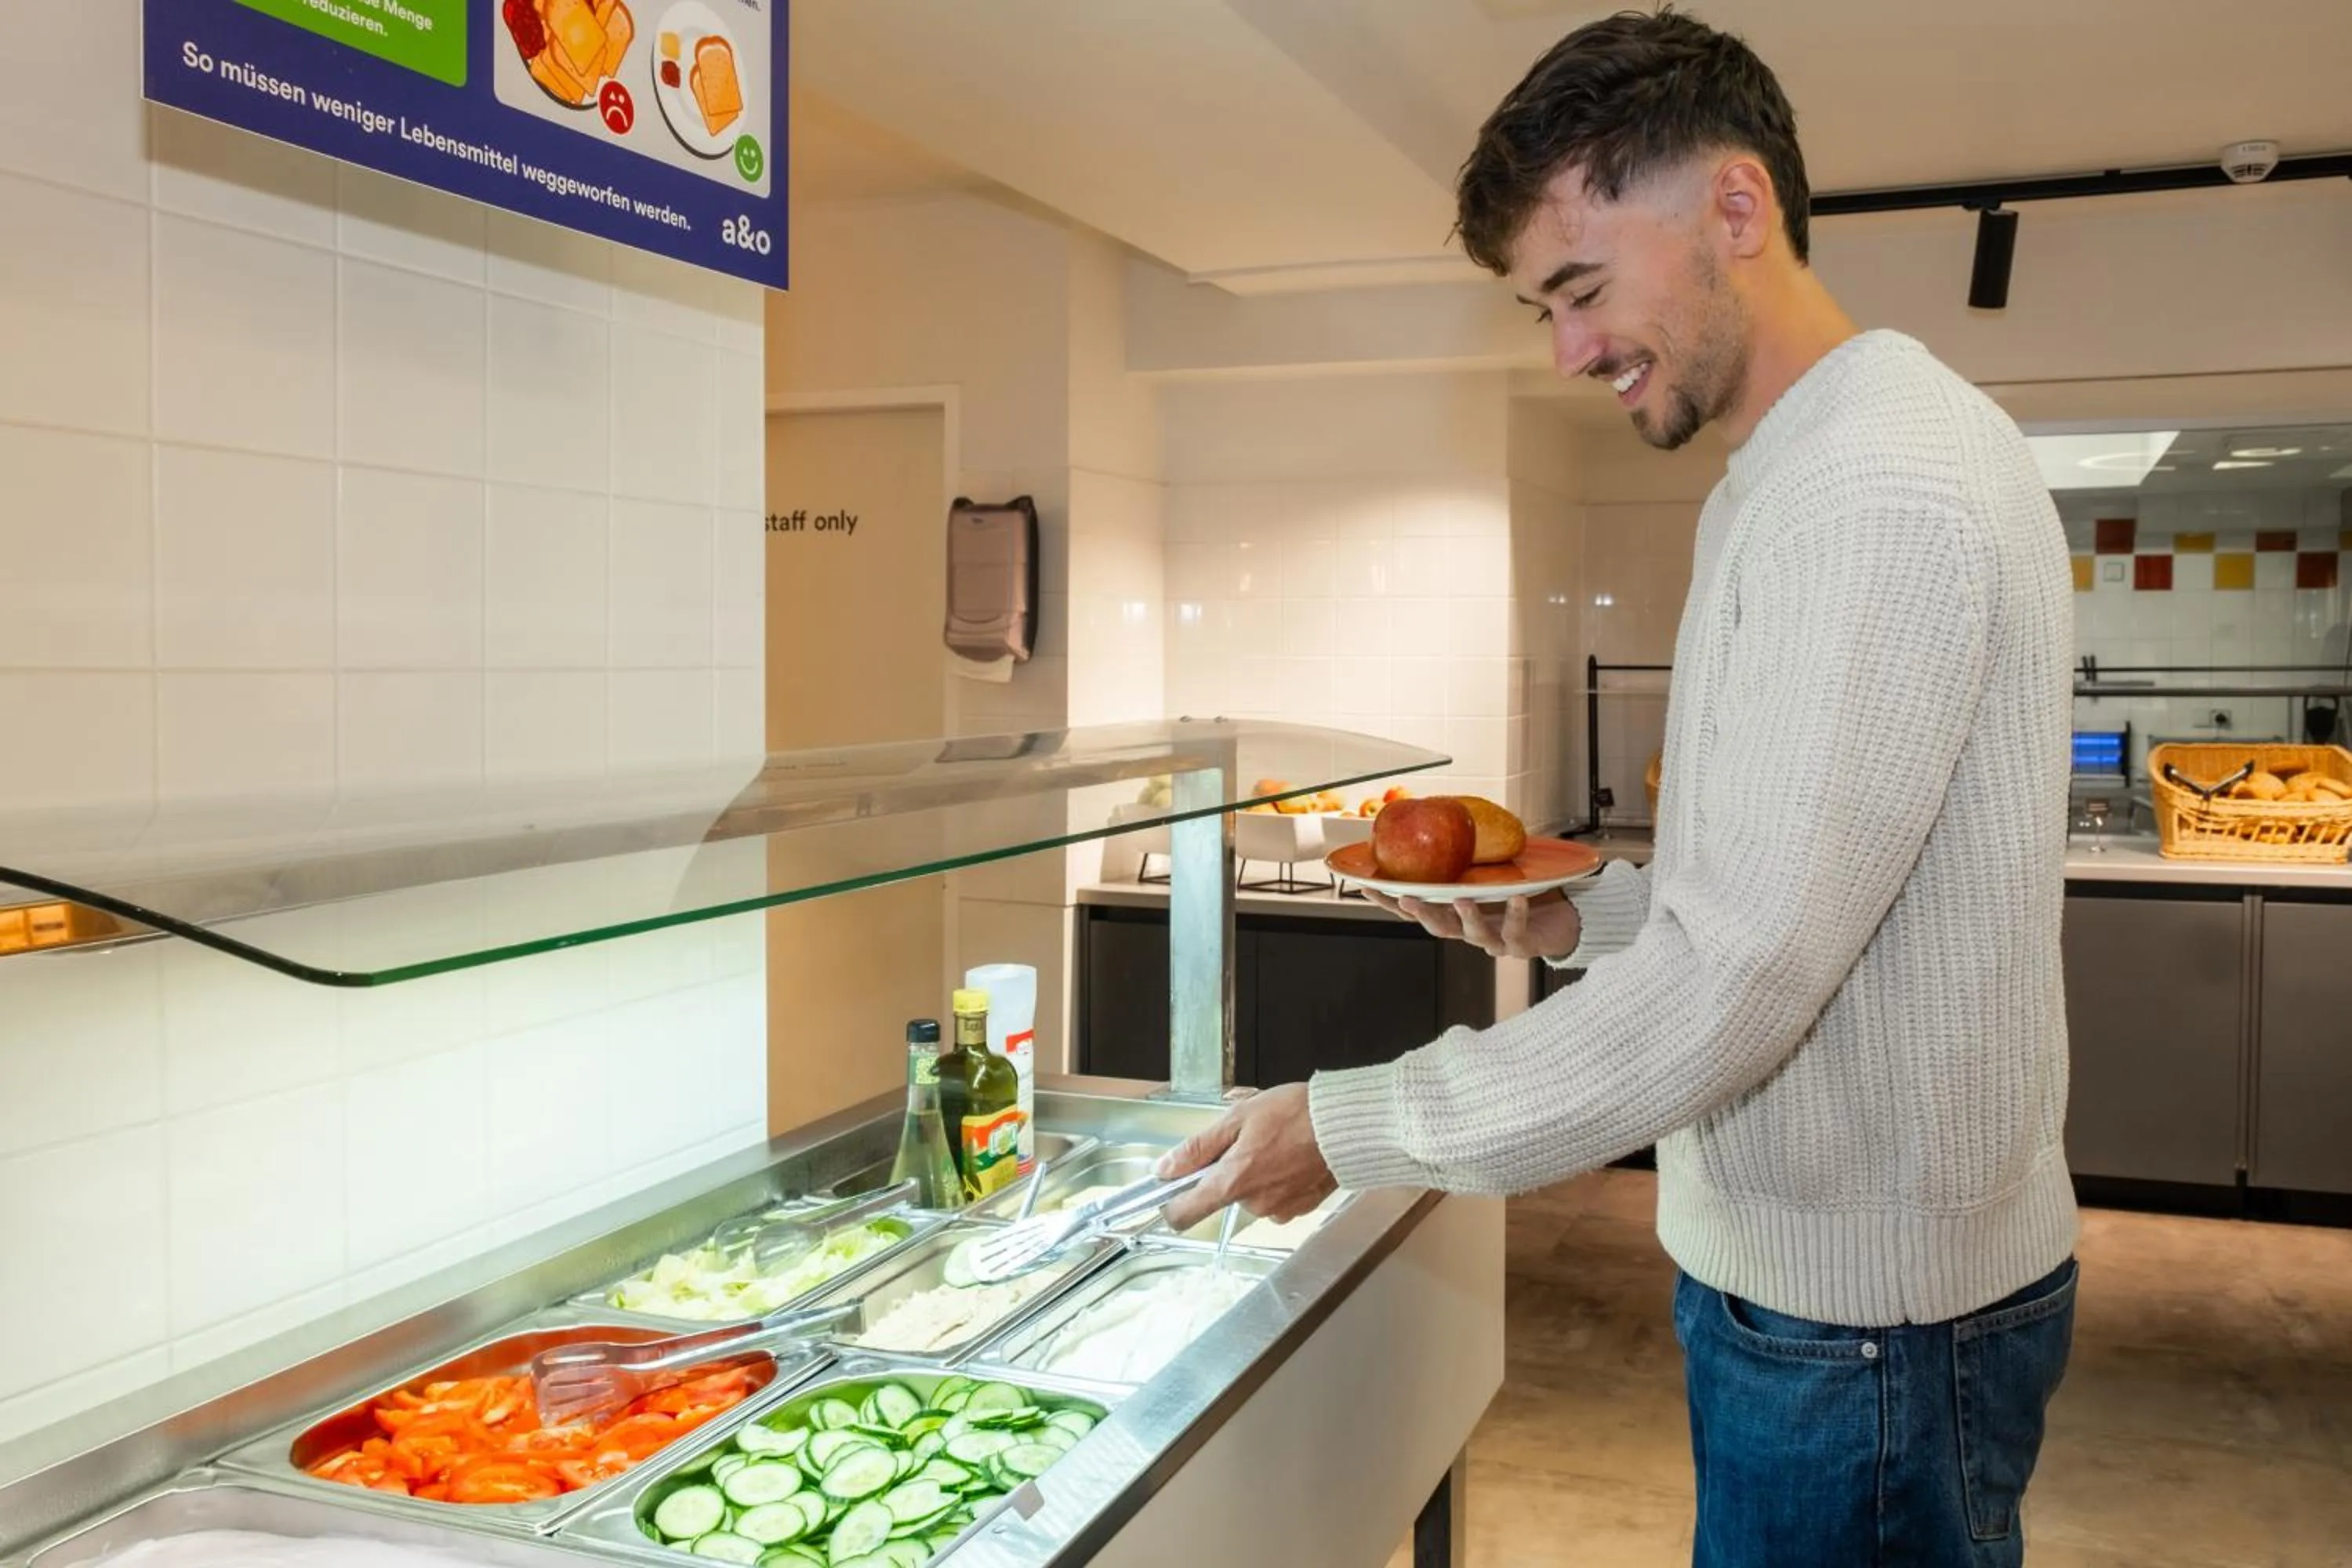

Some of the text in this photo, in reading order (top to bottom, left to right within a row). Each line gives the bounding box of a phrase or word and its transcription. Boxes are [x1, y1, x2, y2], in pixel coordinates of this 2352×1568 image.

[383, 0, 433, 31] Menge
[183, 41, 691, 230] So müssen weniger Lebensmittel weggeworfen werden.
[721, 213, 771, 256] a&o
[815, 509, 858, 536] only
